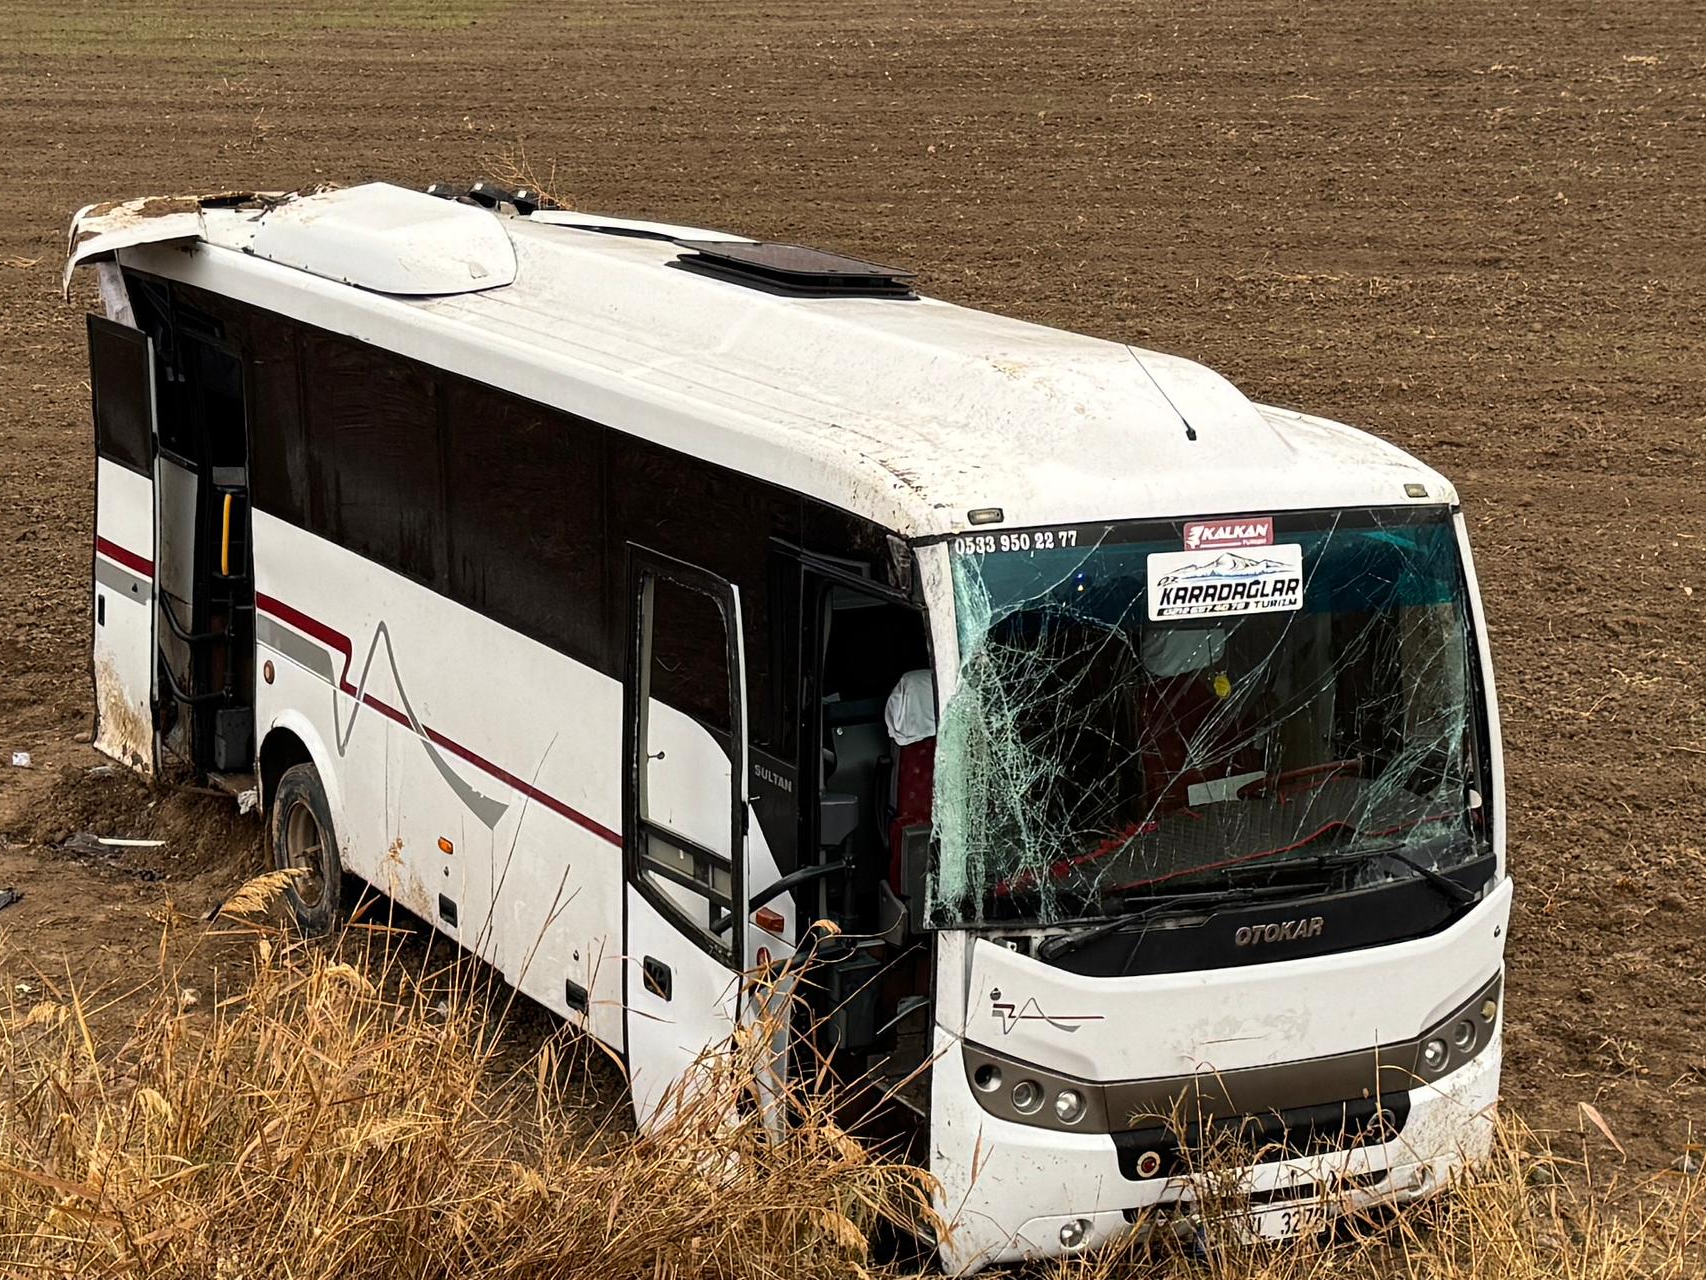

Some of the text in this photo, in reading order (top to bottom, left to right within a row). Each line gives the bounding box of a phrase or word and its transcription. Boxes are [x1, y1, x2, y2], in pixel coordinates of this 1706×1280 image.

[954, 530, 1077, 555] 0533 950 22 77
[1201, 523, 1268, 540] KALKAN
[1159, 577, 1300, 607] KARADAĞLAR
[754, 764, 792, 793] SULTAN
[1235, 916, 1325, 946] OTOKAR
